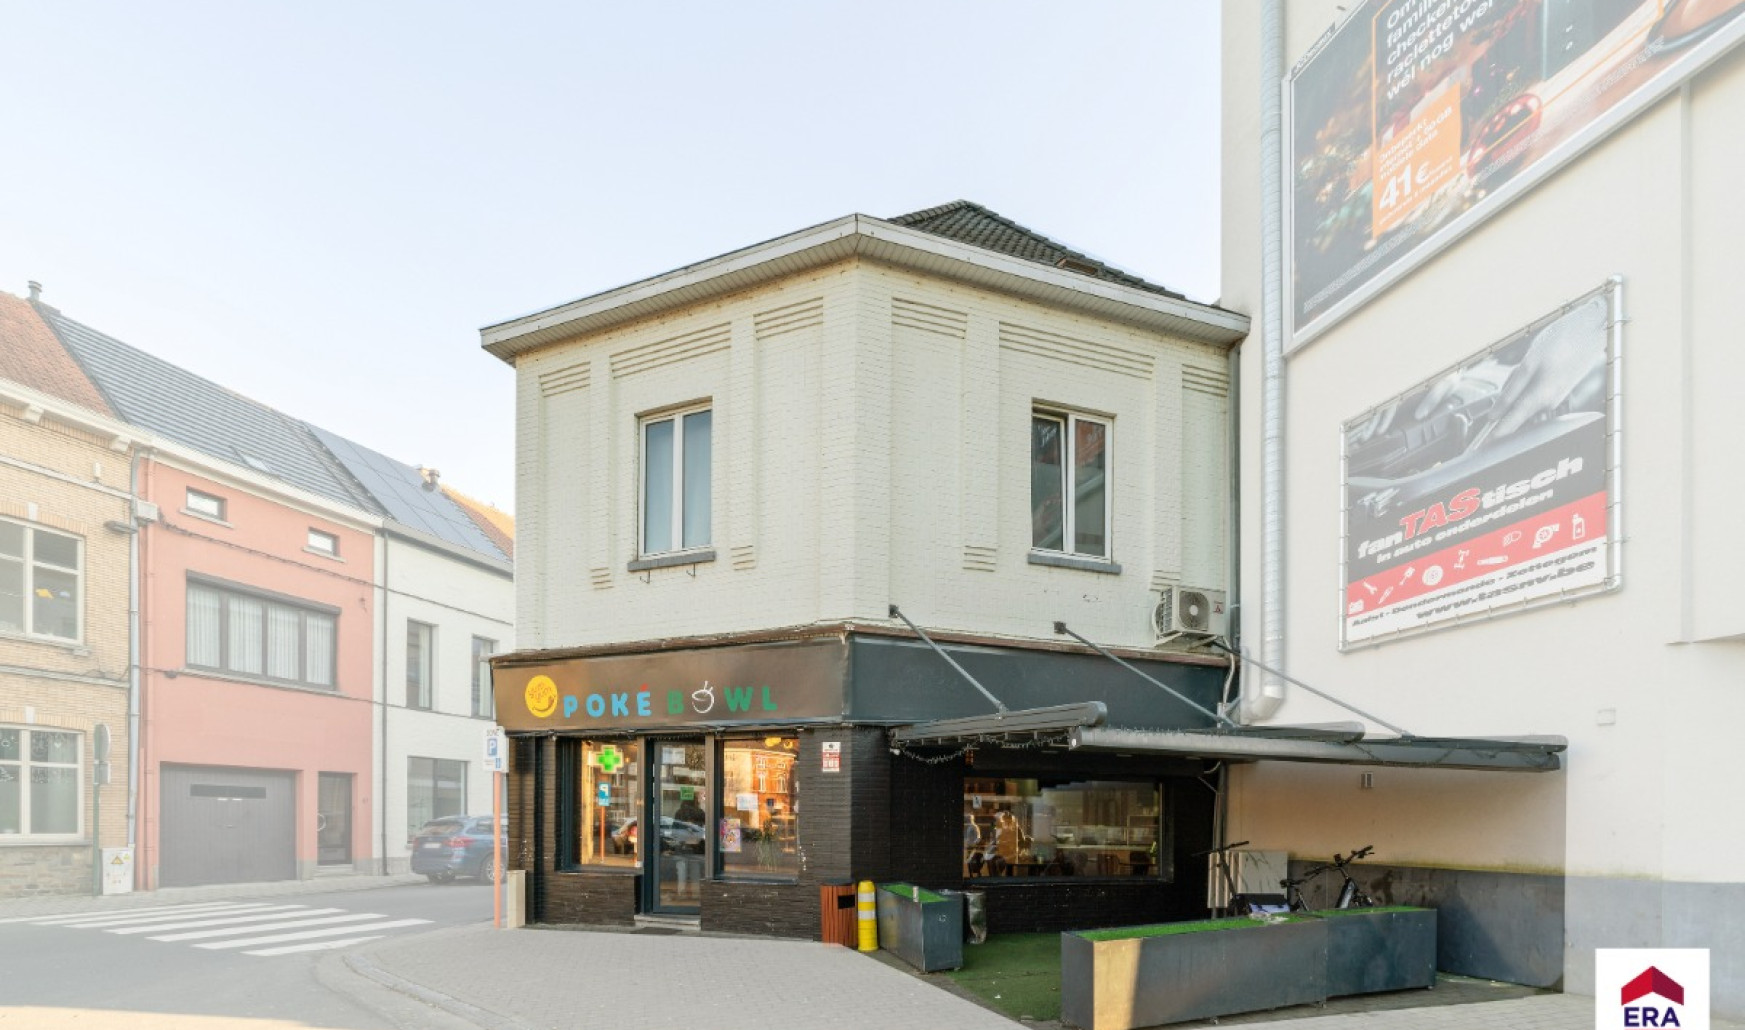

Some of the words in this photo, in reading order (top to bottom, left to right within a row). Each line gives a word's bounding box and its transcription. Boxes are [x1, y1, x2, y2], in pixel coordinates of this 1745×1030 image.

[1421, 31, 1454, 71] nog
[1393, 536, 1433, 557] auto
[1435, 488, 1554, 541] onderdelen
[1416, 560, 1595, 619] www.tasnv.be
[563, 684, 652, 718] POKÉ
